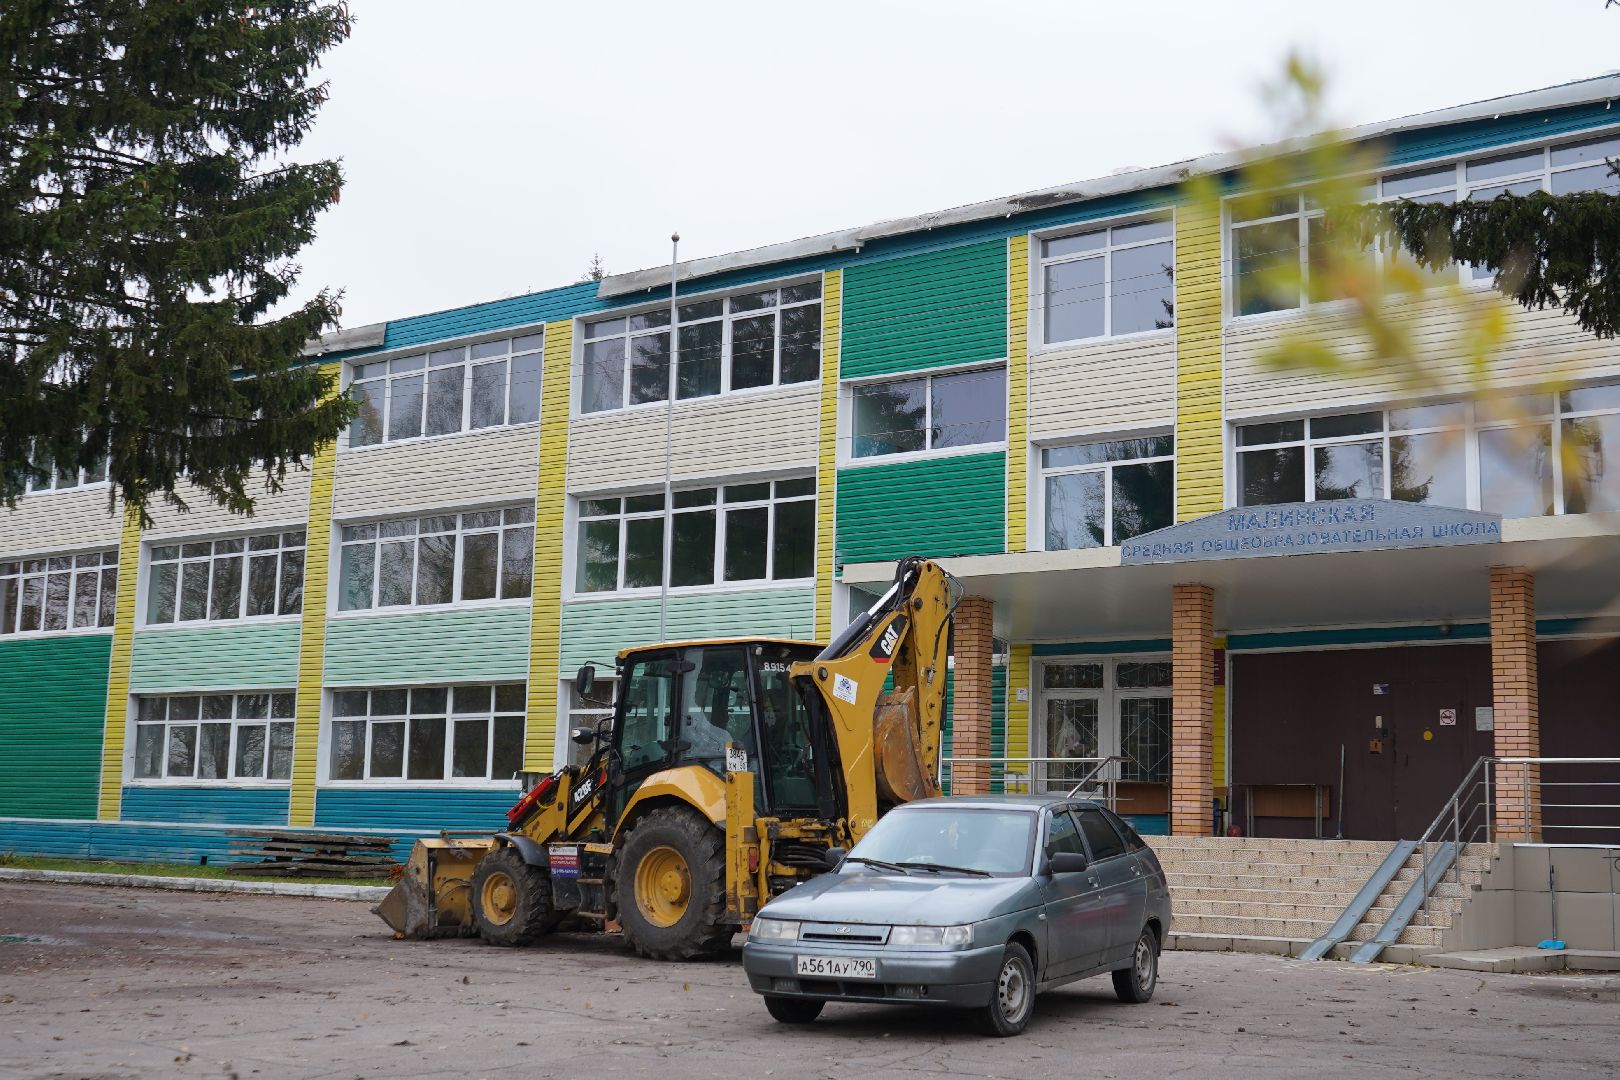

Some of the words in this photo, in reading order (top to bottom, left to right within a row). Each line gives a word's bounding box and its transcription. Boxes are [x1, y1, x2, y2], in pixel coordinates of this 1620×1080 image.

[1228, 504, 1376, 531] МАЛИНСКАЯ
[1121, 542, 1194, 559] СРЕДНЯЯ
[1201, 525, 1424, 553] ОБЩЕОБРАЗОВАТЕЛЬНАЯ
[1431, 521, 1500, 538] ШКОЛА
[880, 624, 899, 656] CAT
[852, 960, 872, 972] 790
